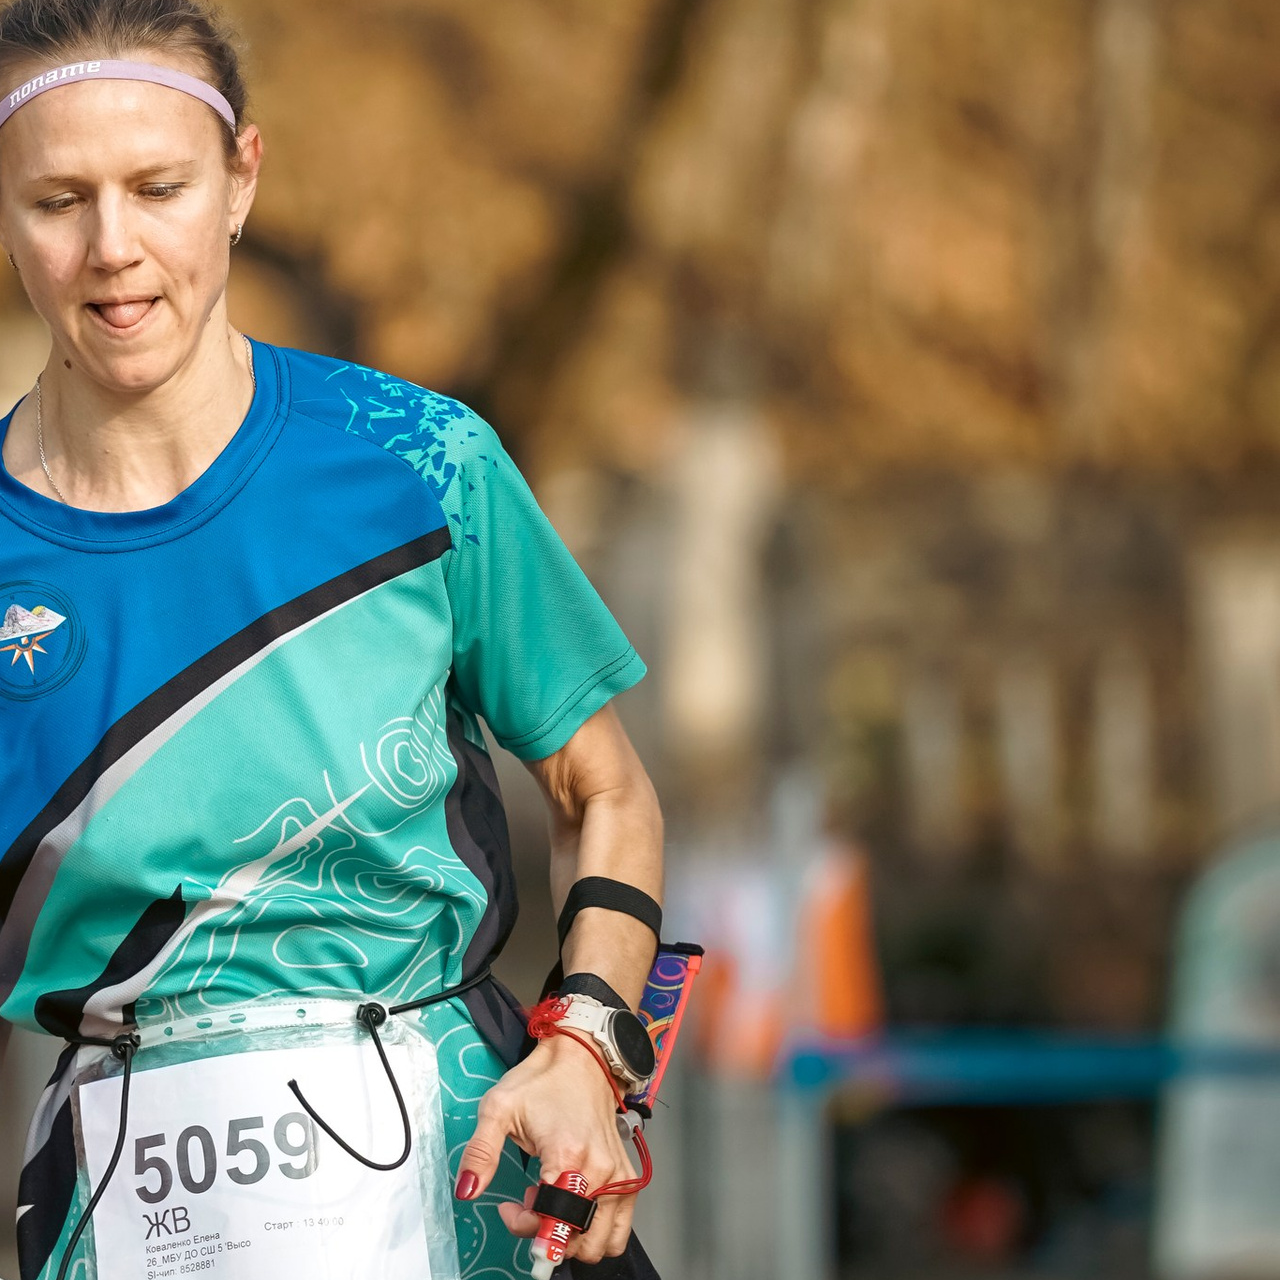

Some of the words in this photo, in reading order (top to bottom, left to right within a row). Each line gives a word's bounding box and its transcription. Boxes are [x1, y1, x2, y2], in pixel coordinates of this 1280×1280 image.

[9, 62, 100, 108] noname
[135, 1112, 320, 1204] 5059
[143, 1206, 191, 1240] ЖВ
[264, 1221, 293, 1231] Старт
[145, 1238, 191, 1254] Коваленко
[193, 1232, 221, 1244] Елена
[184, 1249, 198, 1261] ДО
[200, 1245, 216, 1256] СШ
[217, 1243, 223, 1253] 5
[180, 1258, 215, 1275] 8528881
